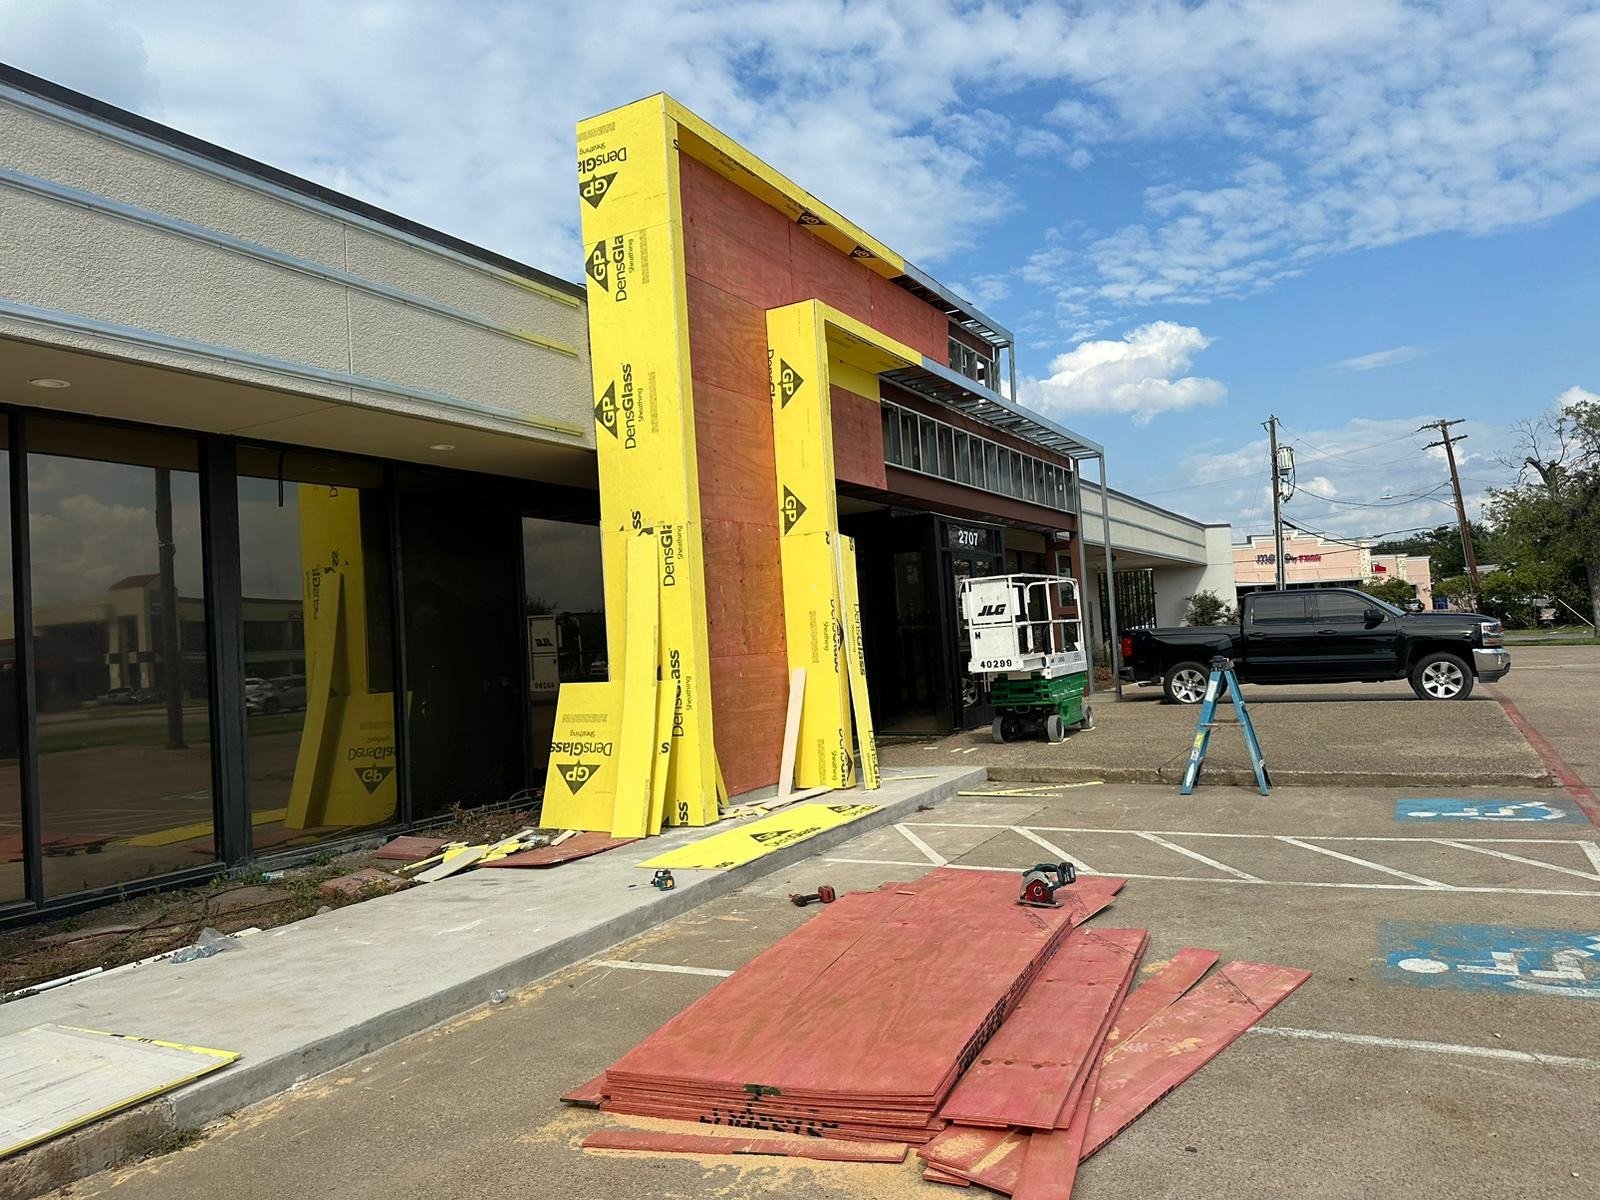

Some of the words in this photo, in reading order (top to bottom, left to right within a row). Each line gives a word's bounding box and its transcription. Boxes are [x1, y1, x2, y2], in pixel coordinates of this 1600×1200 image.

[583, 178, 608, 198] GP
[593, 250, 607, 281] GP
[612, 235, 628, 302] DensGla
[628, 238, 636, 274] Sheathing
[782, 368, 794, 396] GP
[602, 396, 616, 428] GP
[622, 363, 637, 450] DensGlass
[637, 387, 645, 422] Sheathing
[785, 495, 797, 522] GP
[958, 529, 979, 547] 2707
[977, 603, 1007, 617] JLG
[980, 659, 1013, 669] 40299
[685, 675, 693, 711] Sheathing
[570, 729, 596, 738] Sheathing
[565, 766, 590, 782] GP
